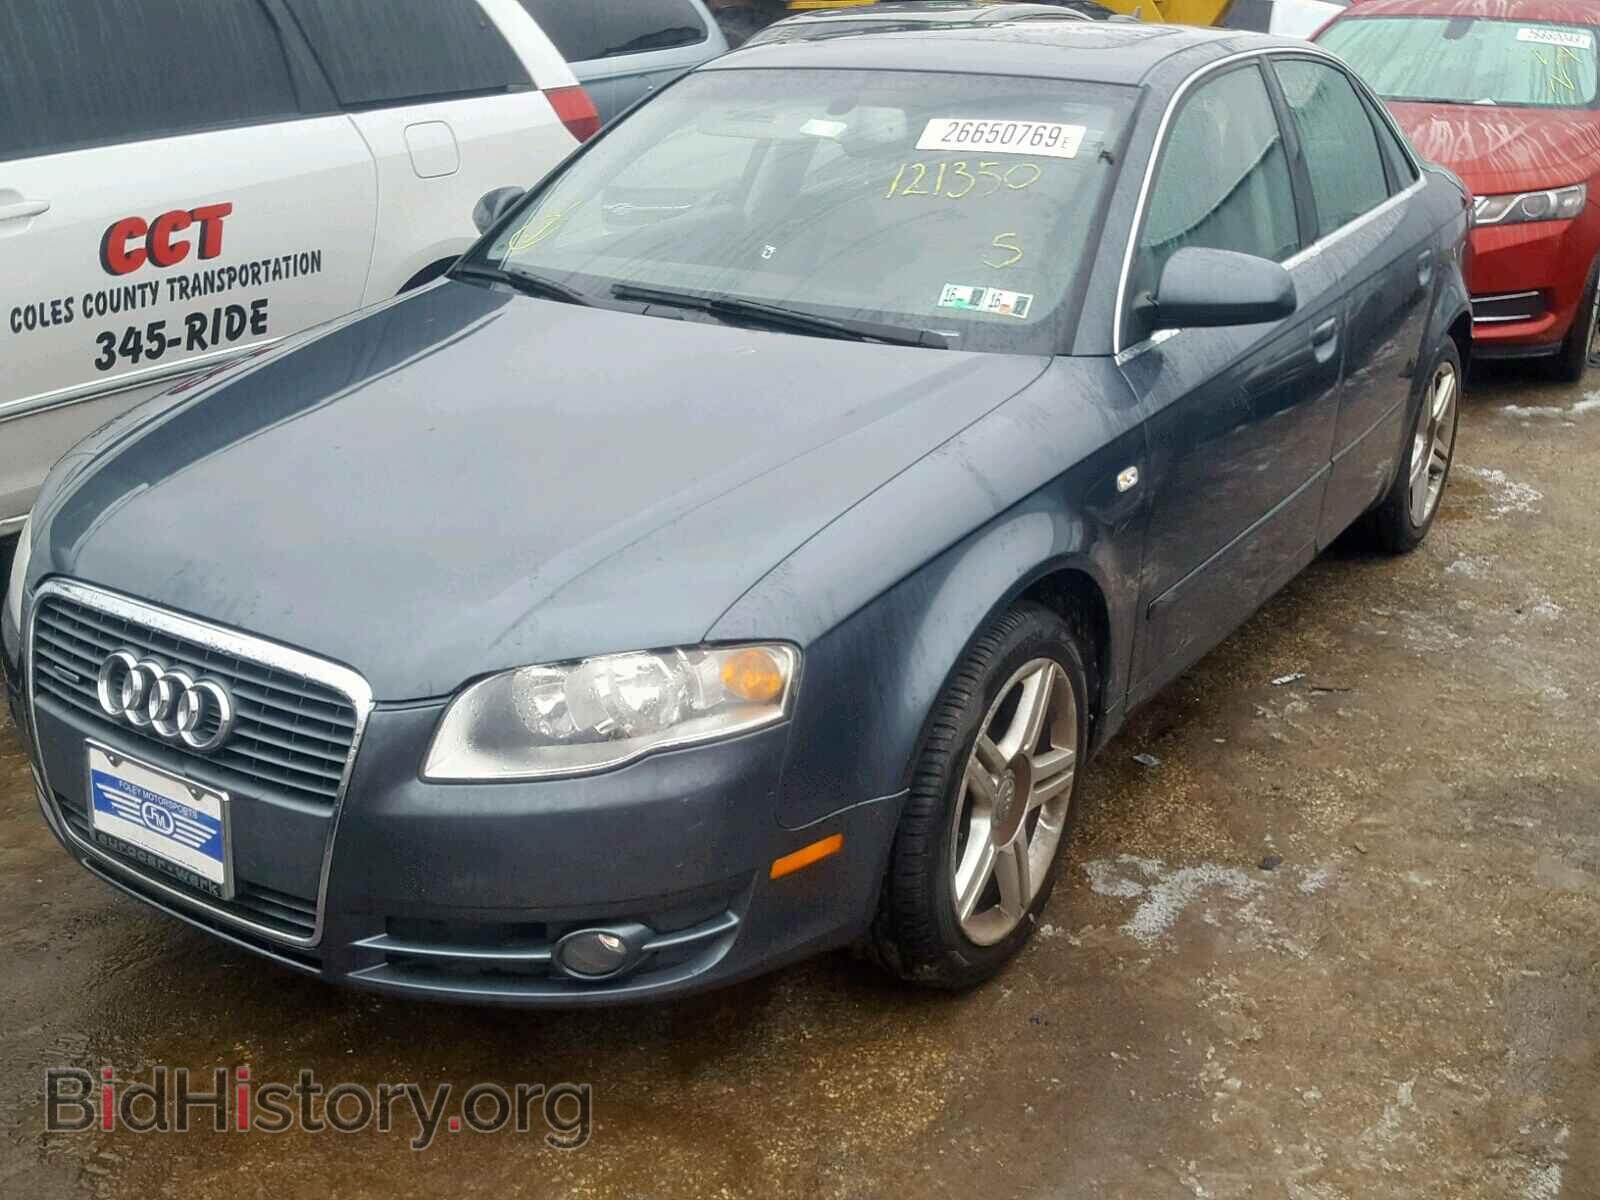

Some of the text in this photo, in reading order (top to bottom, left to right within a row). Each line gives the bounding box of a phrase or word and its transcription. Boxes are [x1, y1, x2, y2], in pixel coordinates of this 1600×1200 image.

[941, 121, 1062, 148] 26650769
[885, 161, 1041, 198] 121350
[100, 202, 232, 275] CCT
[10, 250, 321, 333] COLES COUNTY TRANSPORTATION
[95, 299, 268, 371] 345-RIDE
[119, 781, 198, 819] FOLEY MOTORSPORTS
